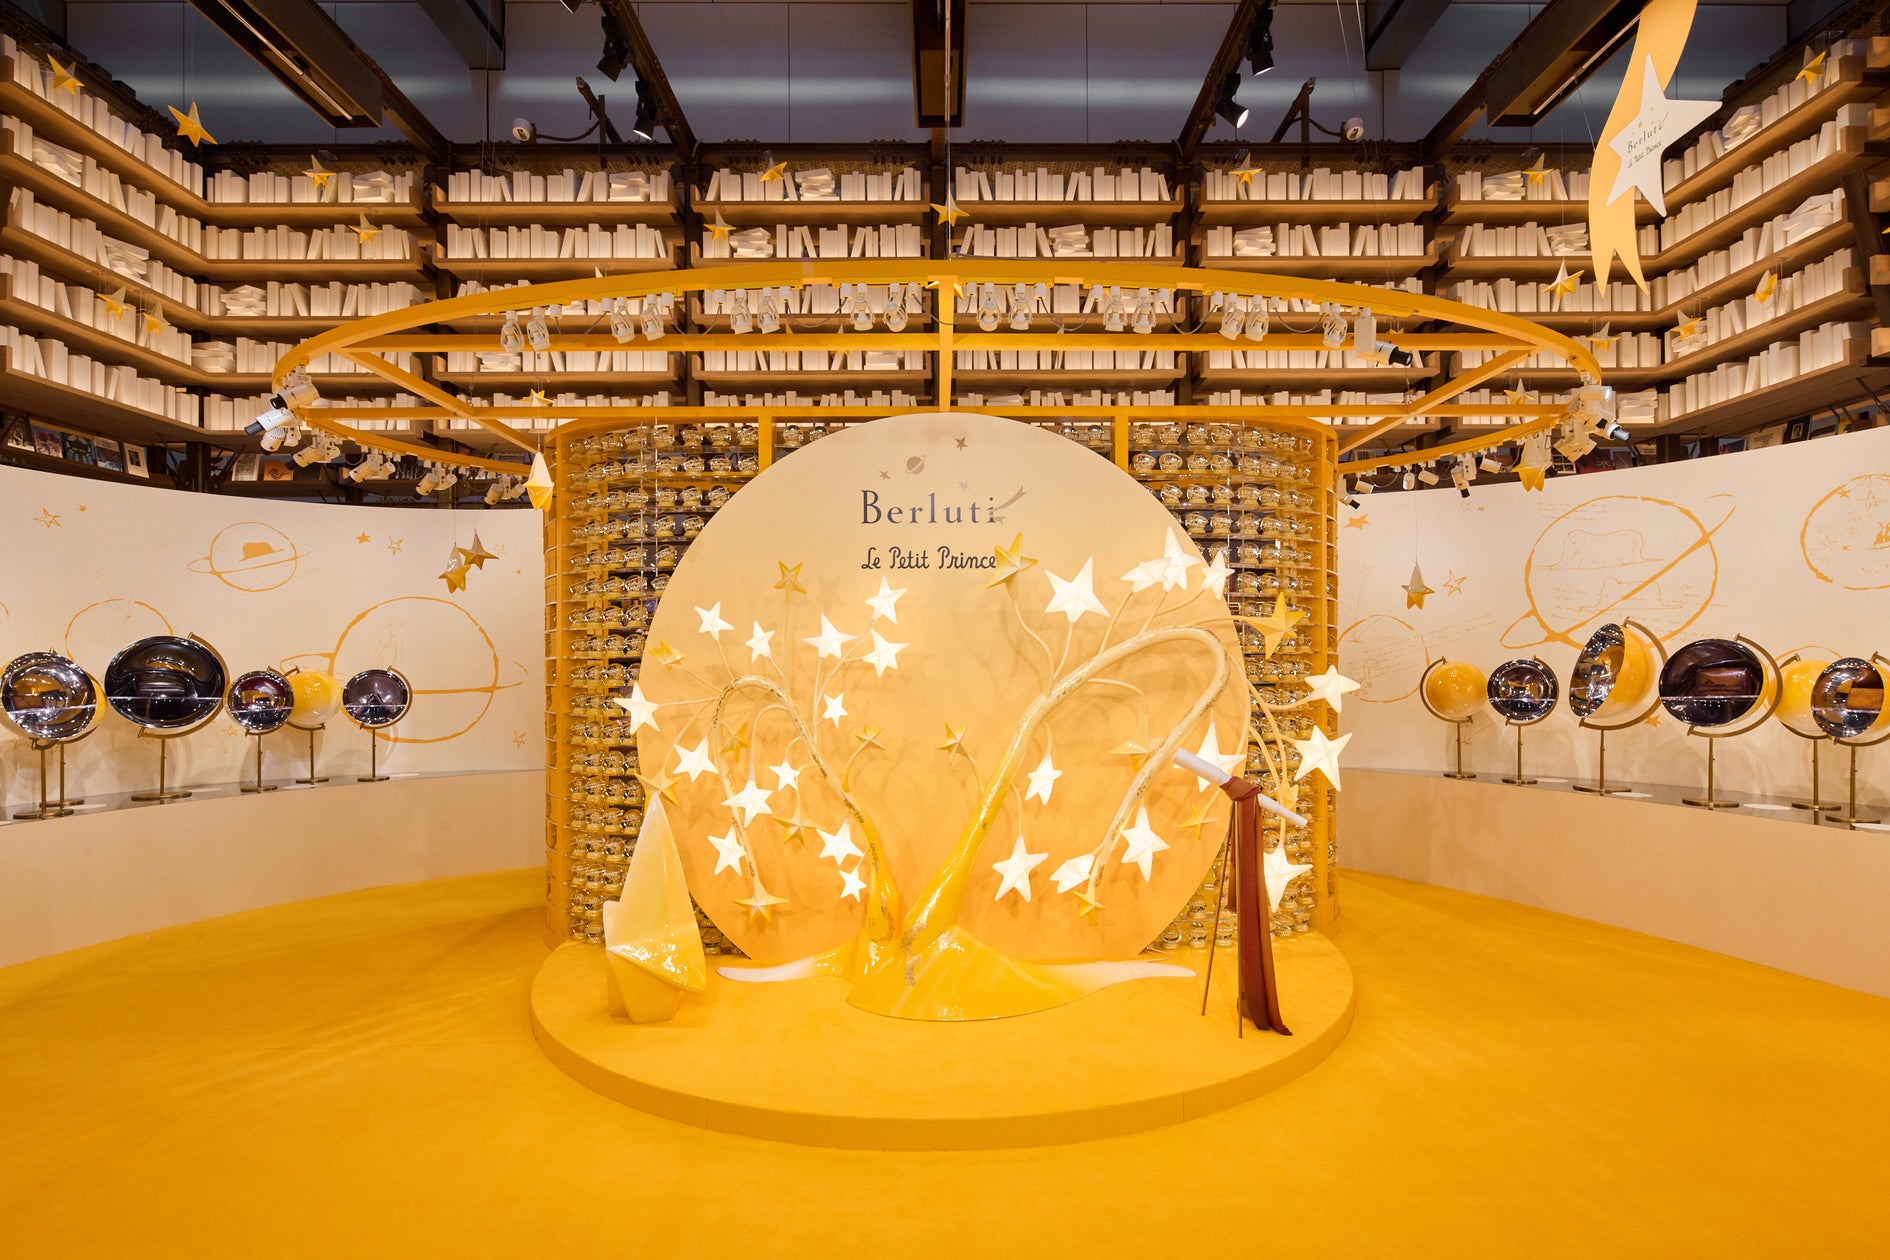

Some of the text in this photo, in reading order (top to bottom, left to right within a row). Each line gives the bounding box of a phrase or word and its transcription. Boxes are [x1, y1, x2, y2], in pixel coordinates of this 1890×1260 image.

[1628, 121, 1663, 153] Berluti
[860, 490, 997, 524] Berluti
[861, 546, 996, 570] Le Petit Prince
